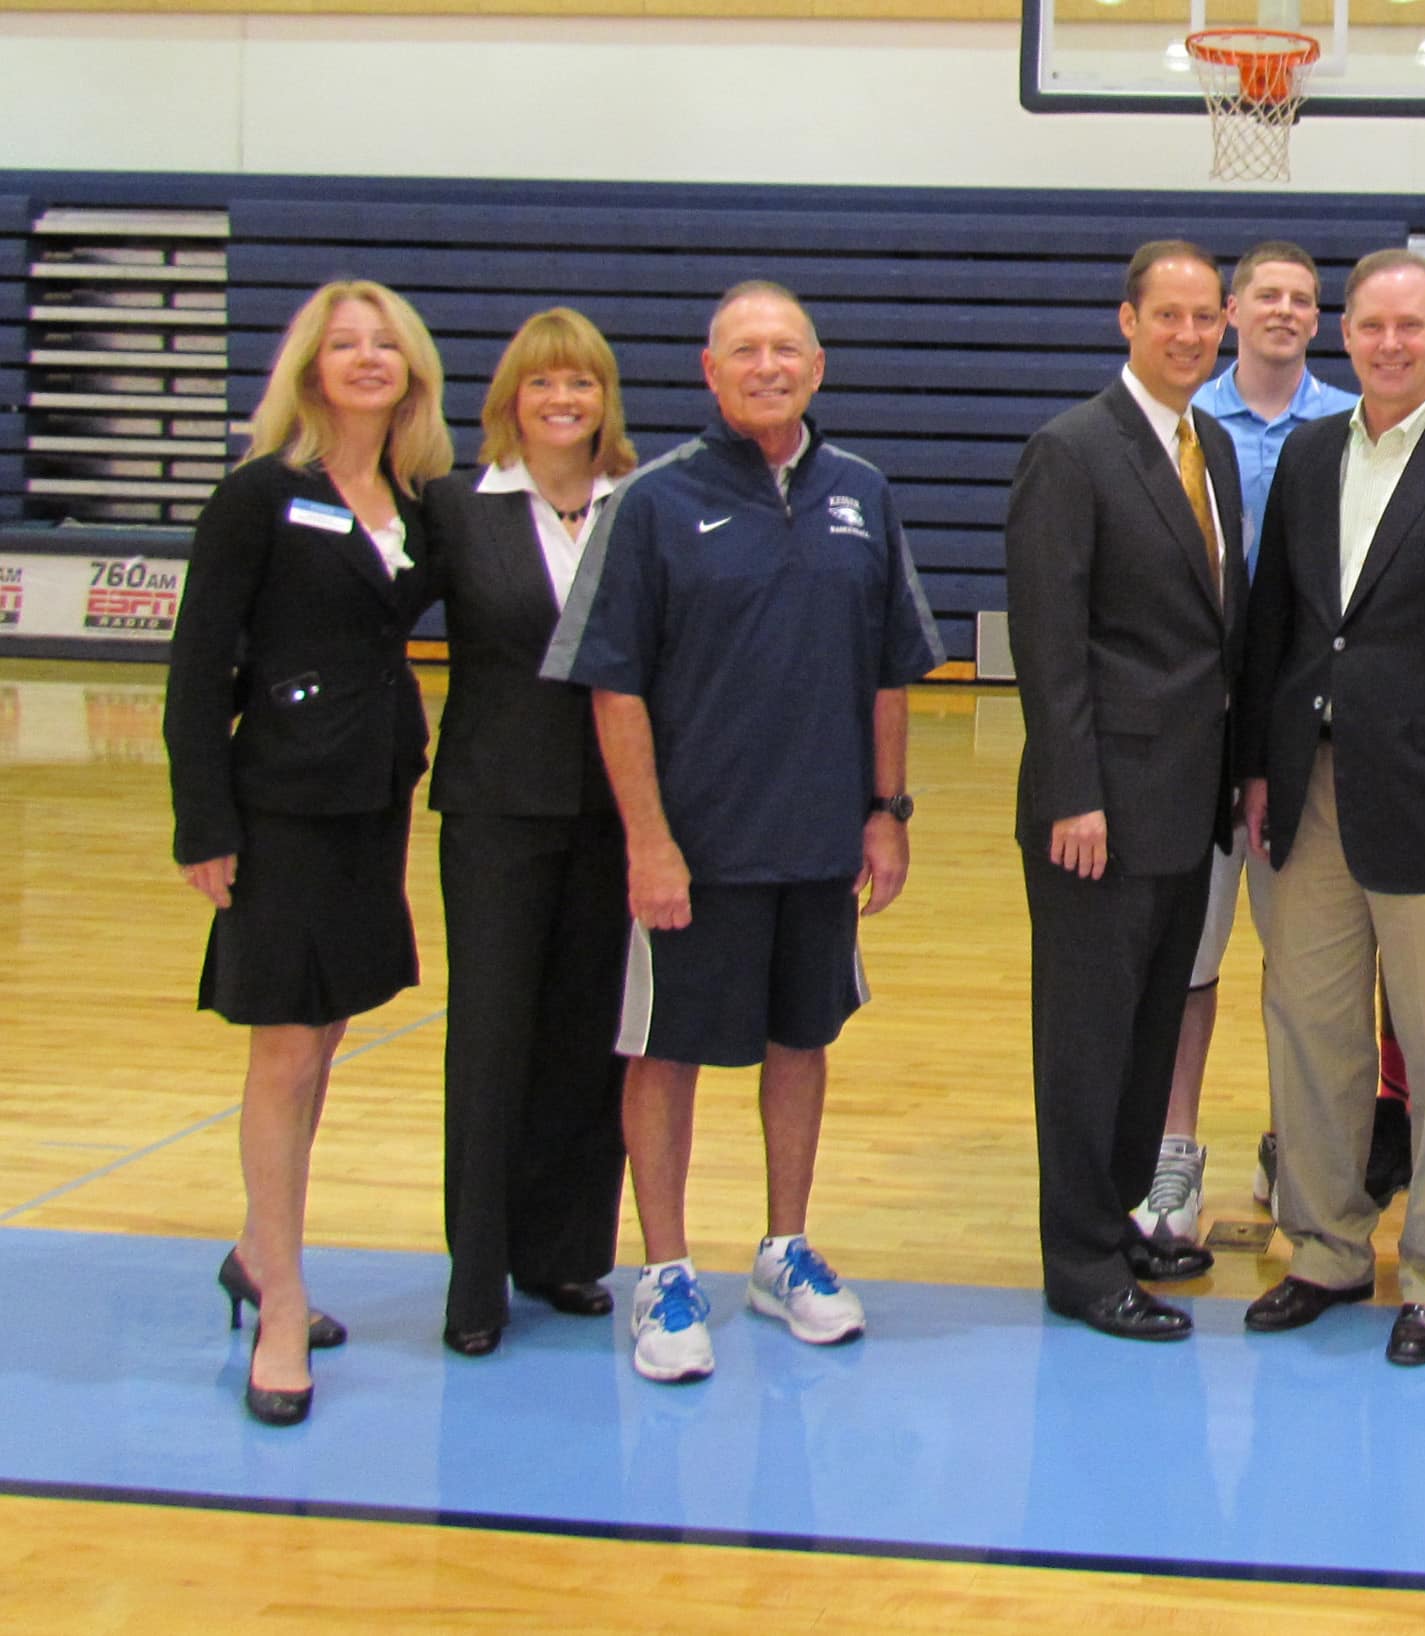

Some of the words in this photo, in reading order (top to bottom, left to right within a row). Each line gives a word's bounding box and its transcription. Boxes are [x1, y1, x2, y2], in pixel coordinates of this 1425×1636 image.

[89, 561, 147, 588] 760
[145, 574, 177, 590] AM
[87, 588, 177, 615] ESPN
[100, 615, 160, 629] RADIO
